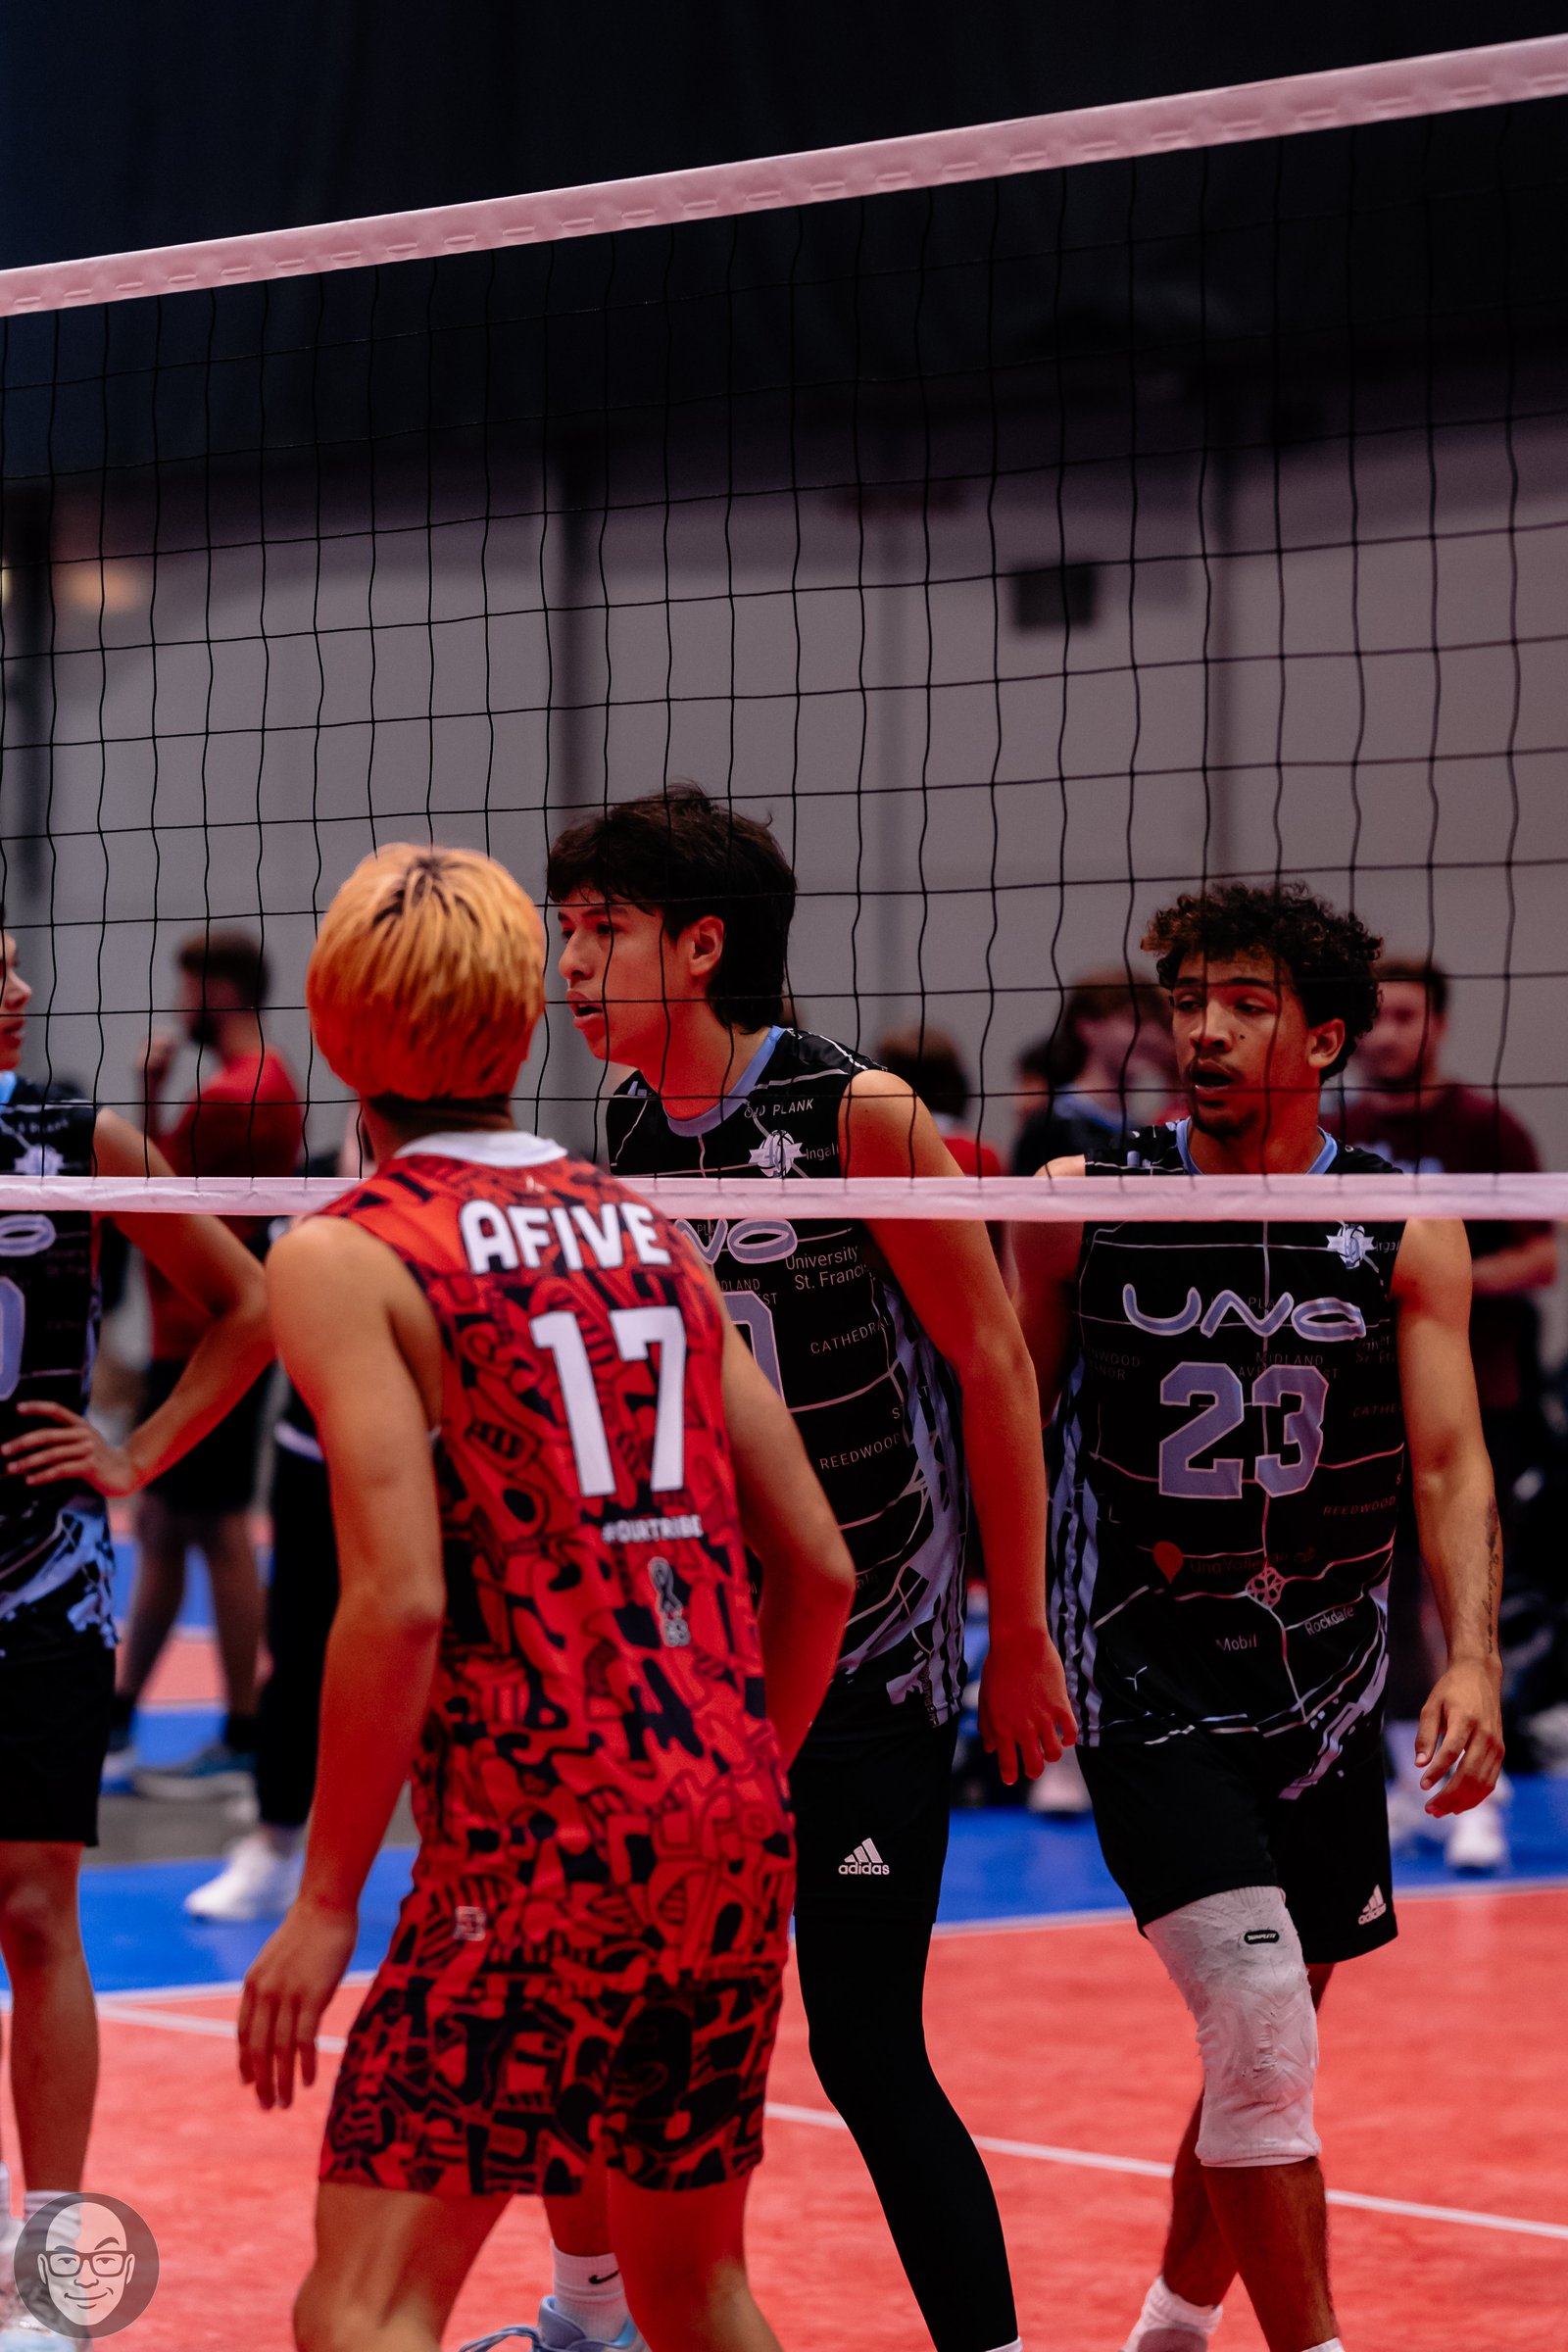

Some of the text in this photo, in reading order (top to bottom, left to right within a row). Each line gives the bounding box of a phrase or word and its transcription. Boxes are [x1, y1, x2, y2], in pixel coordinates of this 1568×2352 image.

[772, 1098, 814, 1116] PLANK
[458, 1199, 671, 1275] AFIVE
[785, 1245, 859, 1271] University
[794, 1274, 815, 1292] St.
[1122, 1283, 1367, 1343] UNO
[808, 1315, 892, 1354] CATHEDRAL
[1255, 1350, 1324, 1366] MIDLAND
[528, 1306, 683, 1497] 17
[1159, 1361, 1330, 1499] 23
[1304, 1605, 1355, 1636] Rockdale
[1215, 1634, 1257, 1652] Mobil
[838, 1862, 891, 1876] adidas
